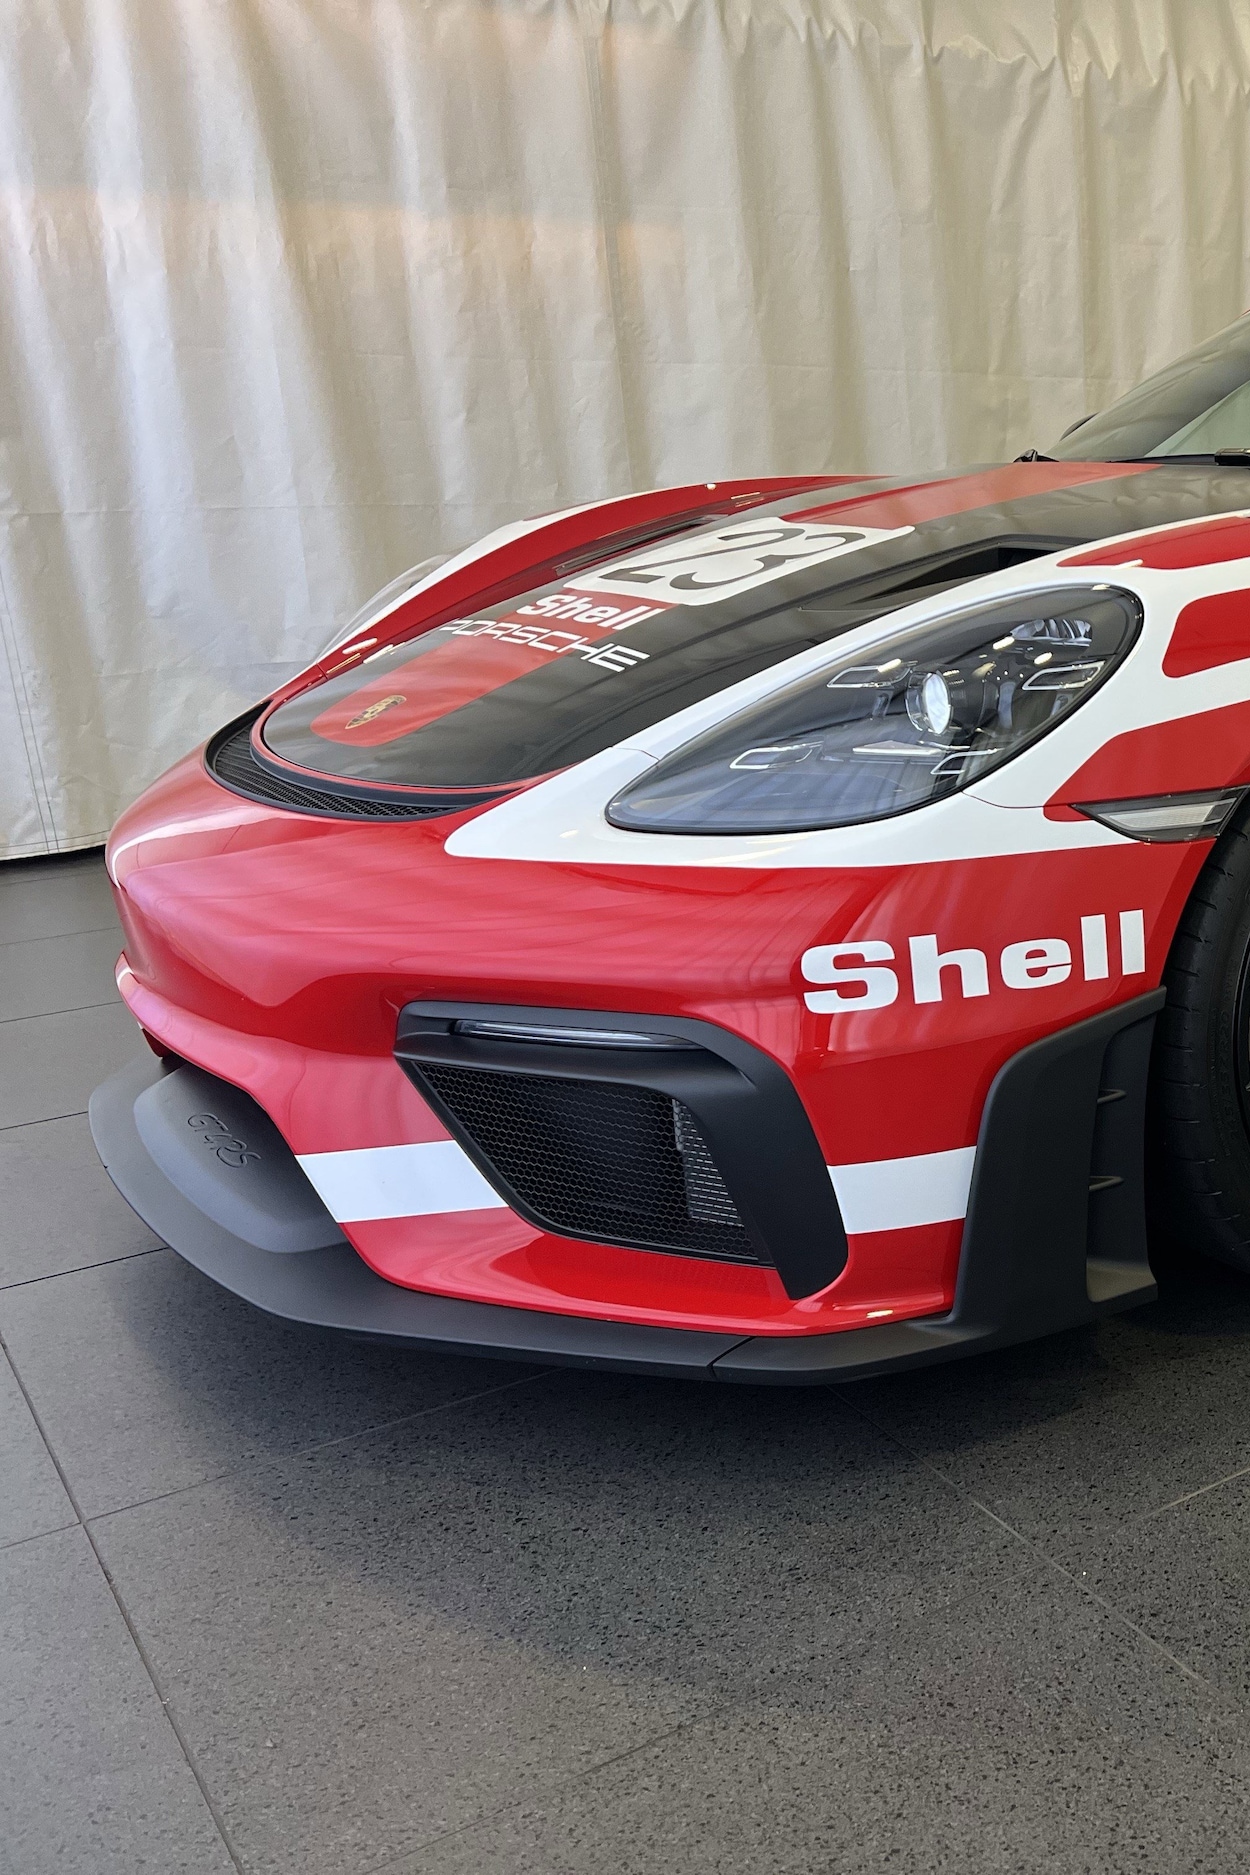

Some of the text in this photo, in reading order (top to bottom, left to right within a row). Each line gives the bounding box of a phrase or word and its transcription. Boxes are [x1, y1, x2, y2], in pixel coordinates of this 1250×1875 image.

[600, 527, 866, 591] 23
[516, 594, 666, 630] Shell
[439, 618, 650, 672] PORSCHE
[800, 909, 1145, 1015] Shell
